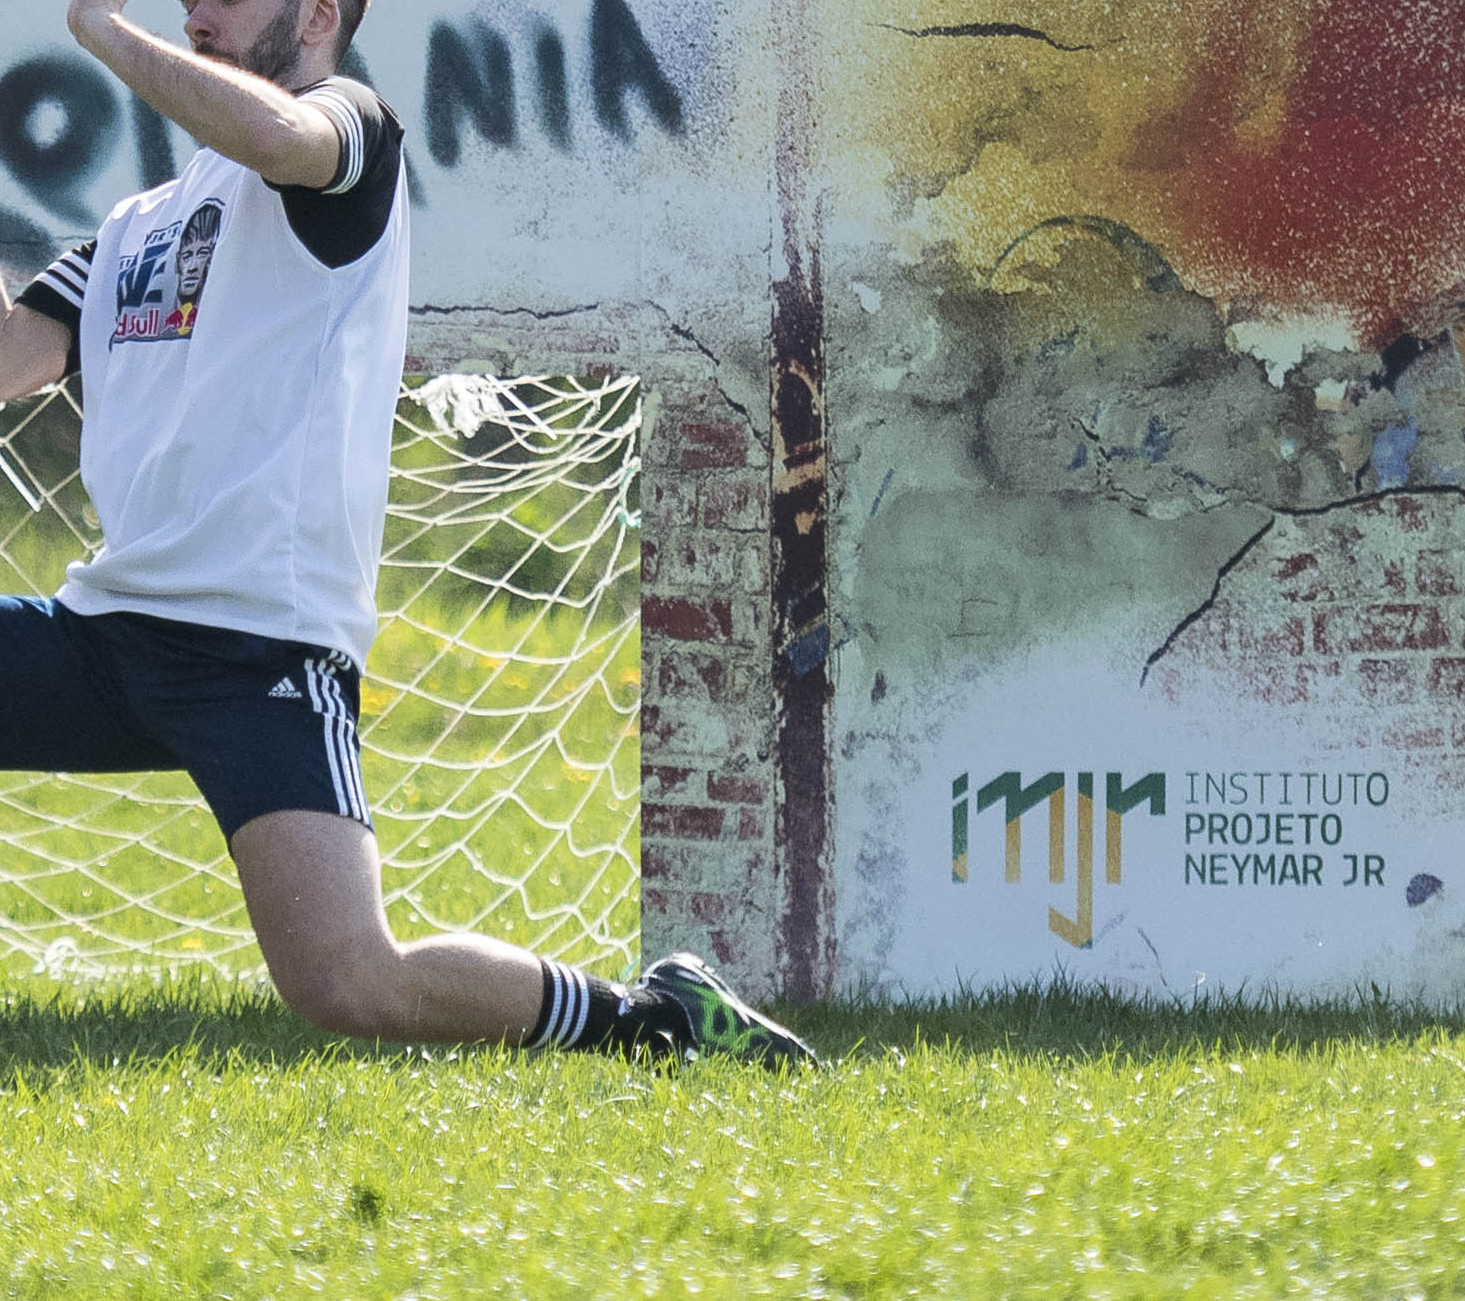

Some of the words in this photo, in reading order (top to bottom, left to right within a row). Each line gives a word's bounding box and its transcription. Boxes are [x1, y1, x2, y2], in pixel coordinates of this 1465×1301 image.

[1185, 771, 1390, 807] INSTITUTO
[1184, 812, 1343, 845] PROJETO
[1184, 854, 1323, 886] NEYMAR
[1343, 854, 1386, 886] JR
